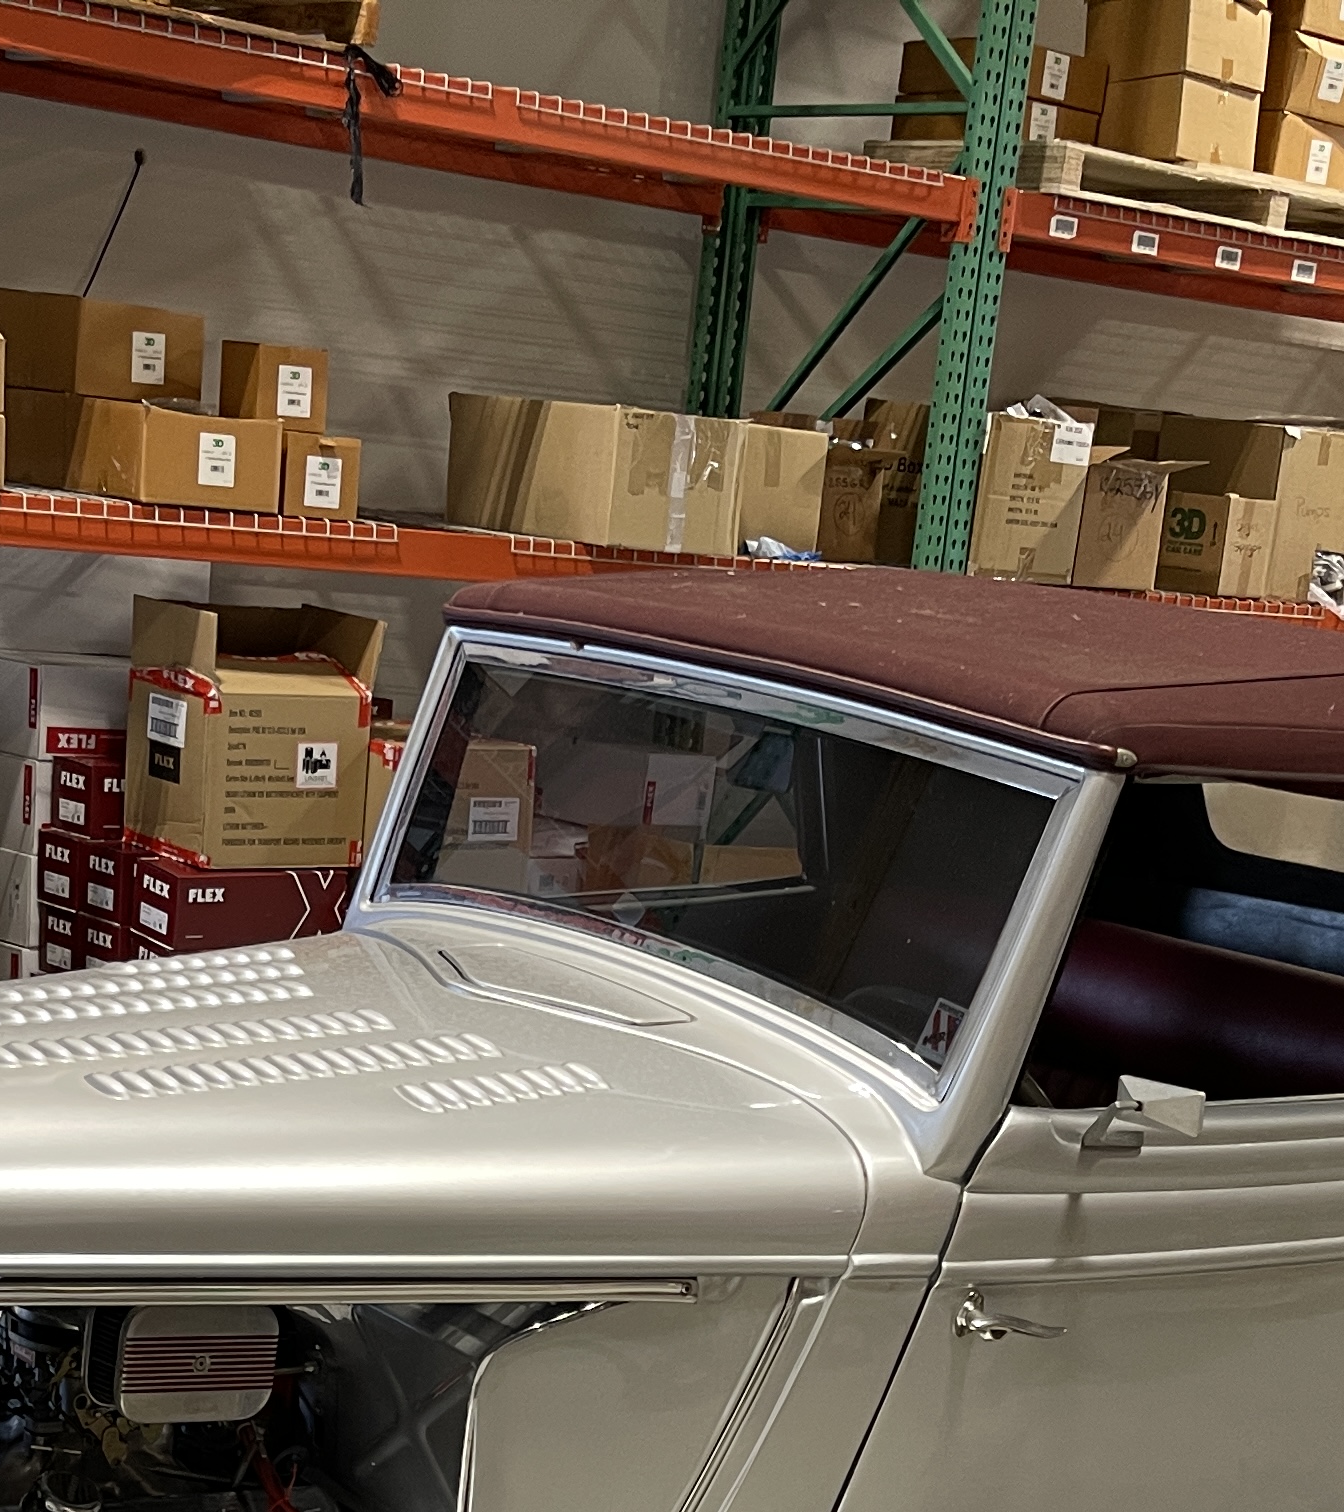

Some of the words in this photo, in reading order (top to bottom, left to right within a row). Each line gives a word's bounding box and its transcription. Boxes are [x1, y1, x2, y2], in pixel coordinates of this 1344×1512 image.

[212, 439, 224, 448] 3D
[1168, 507, 1207, 540] 3D
[163, 669, 194, 692] FLEX
[58, 733, 96, 750] FLEX
[155, 753, 175, 770] FLEX
[60, 771, 86, 790] FLEX
[104, 778, 126, 793] FL
[45, 844, 70, 864] FLEX
[89, 855, 115, 876] FLEX
[143, 874, 170, 899] FLEX
[188, 888, 225, 903] FLEX
[48, 915, 72, 936] FLEX
[87, 928, 113, 949] FLEX
